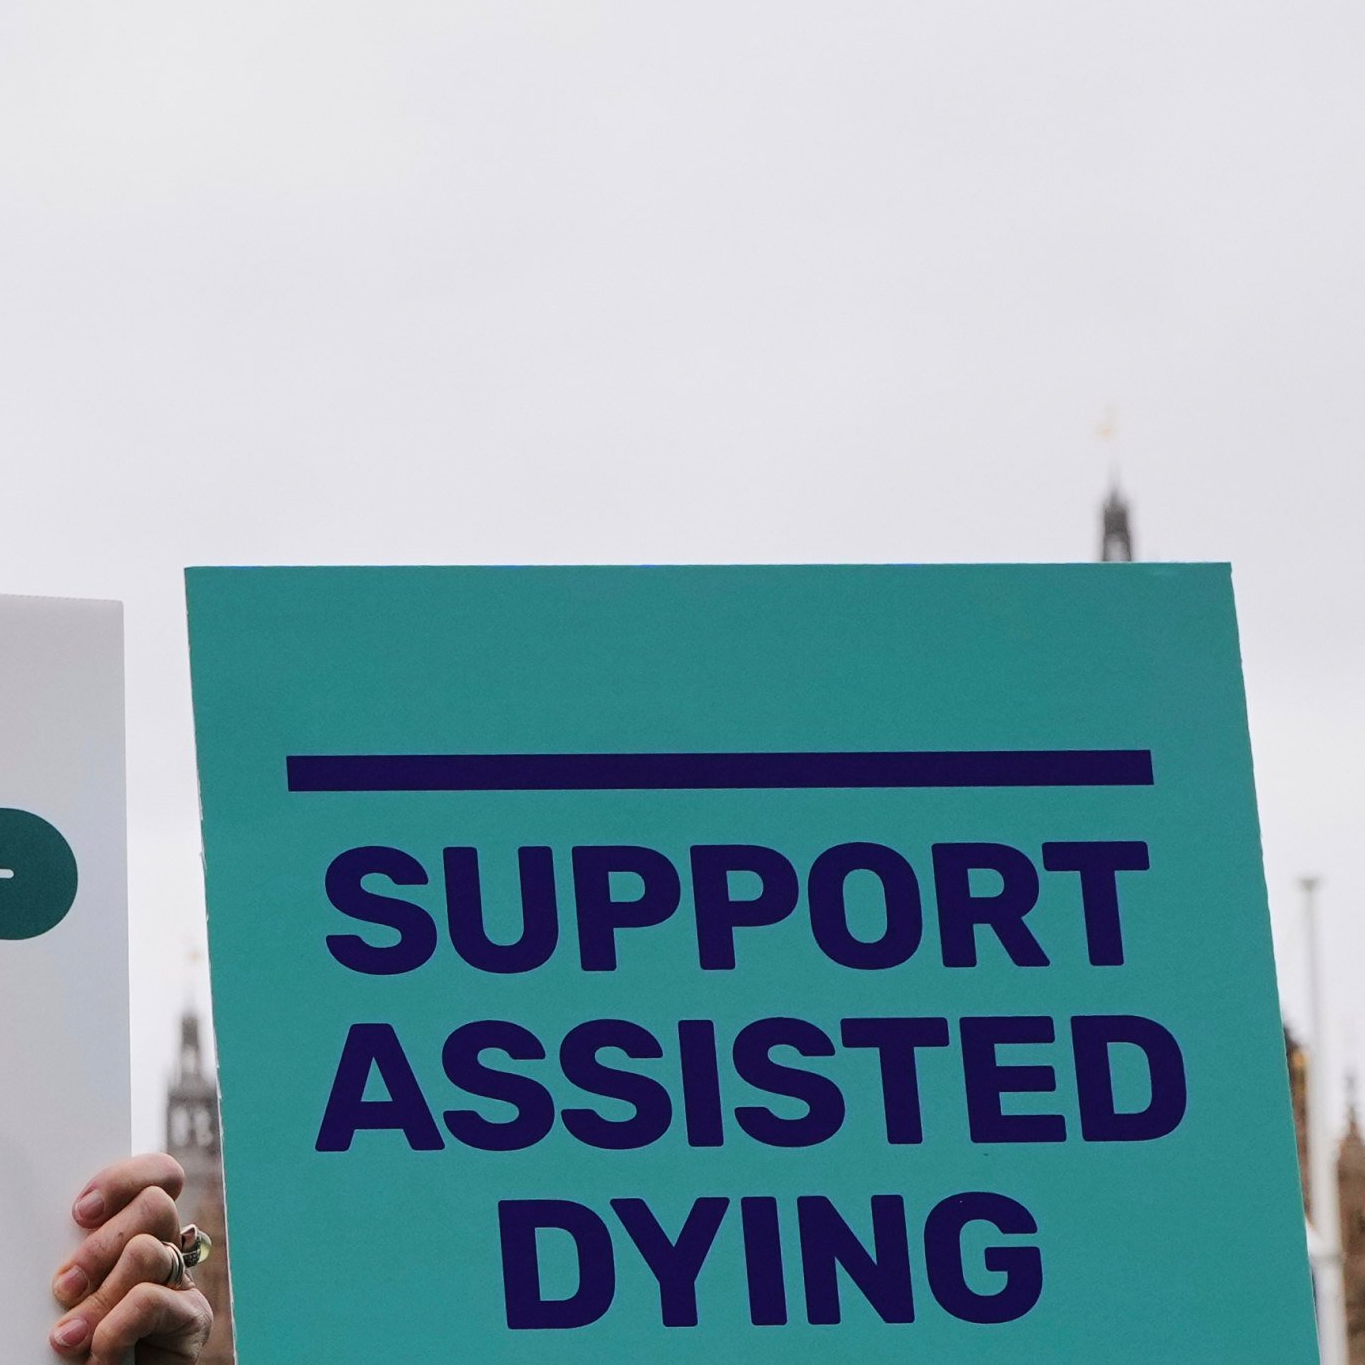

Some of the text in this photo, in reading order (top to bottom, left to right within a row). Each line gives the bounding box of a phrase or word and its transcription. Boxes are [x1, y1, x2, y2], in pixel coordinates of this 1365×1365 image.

[325, 841, 1150, 975] SUPPORT
[315, 1015, 1187, 1152] ASSISTED
[498, 1192, 1043, 1329] DYING
